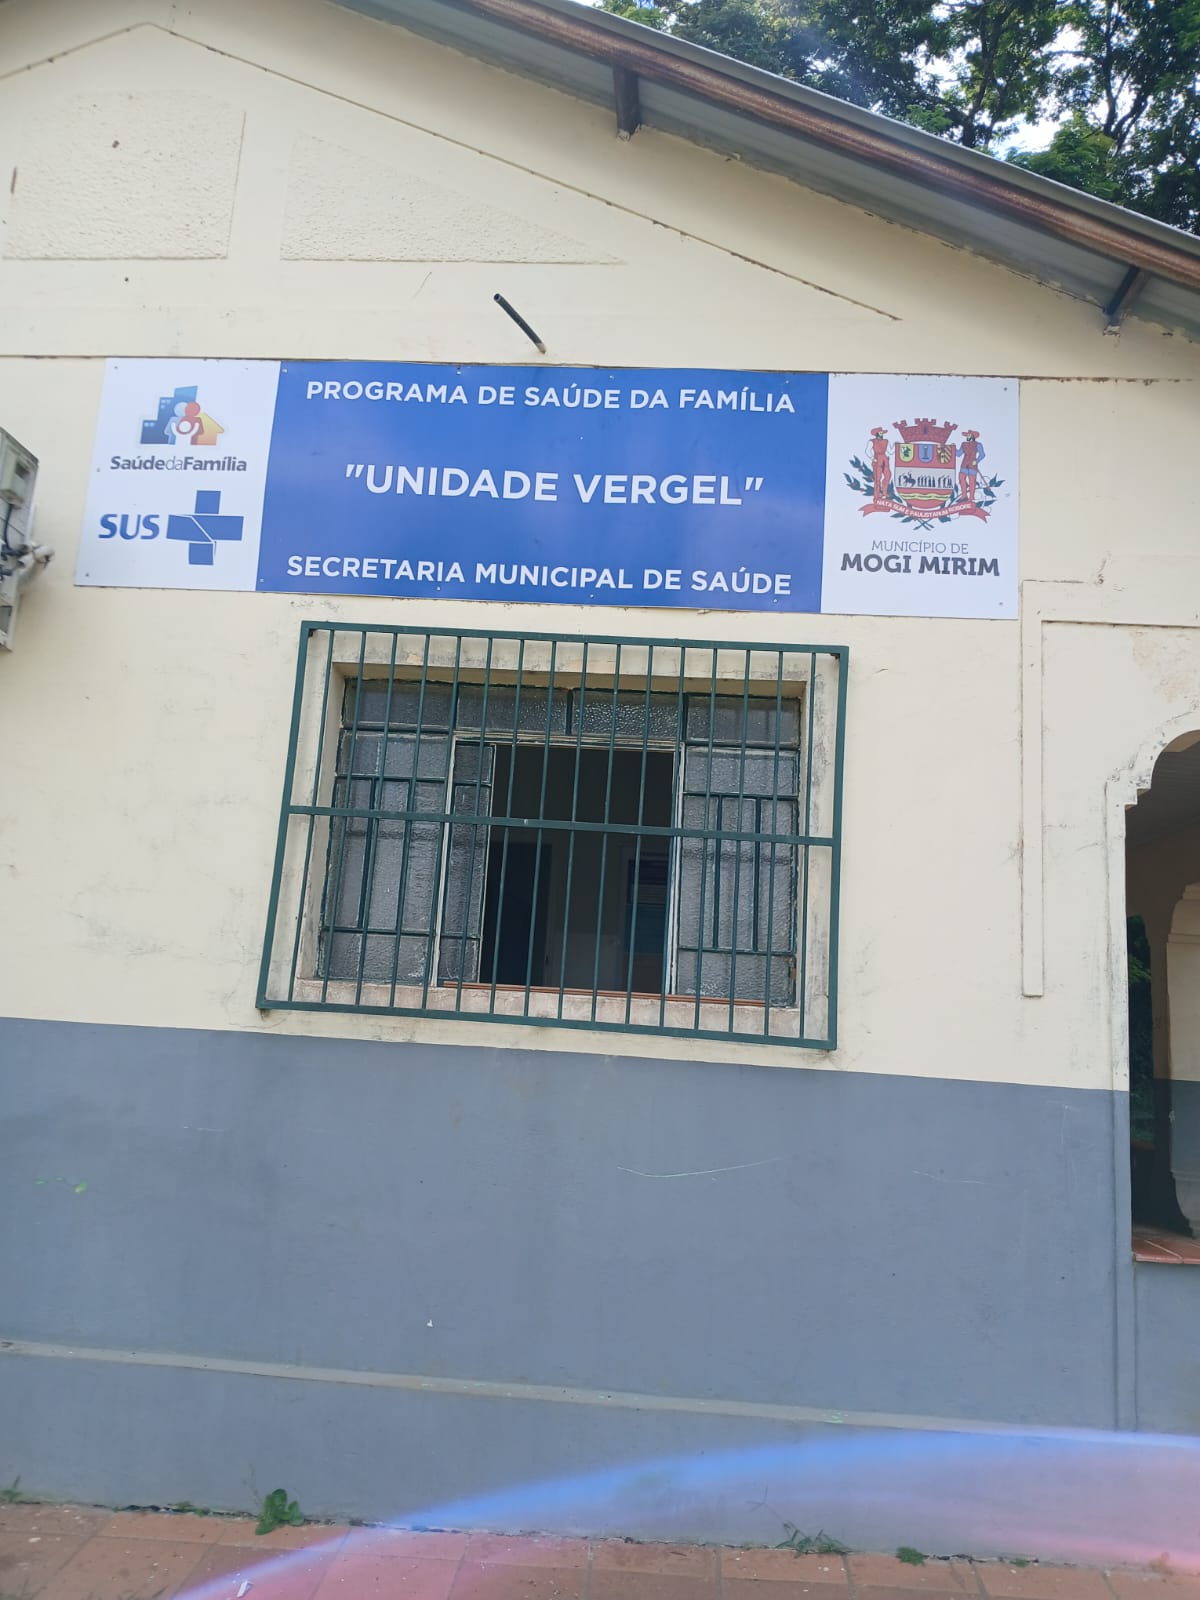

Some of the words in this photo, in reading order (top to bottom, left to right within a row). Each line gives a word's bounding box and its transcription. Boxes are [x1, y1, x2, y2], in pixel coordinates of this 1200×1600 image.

[306, 381, 468, 404] PROGRAMA
[478, 386, 515, 406] DE
[524, 383, 620, 409] SAÚDE
[630, 389, 669, 409] DA
[679, 386, 795, 413] FAMÍLIA
[345, 464, 559, 501] "UNIDADE
[98, 514, 160, 540] SUS
[871, 540, 947, 554] MUNICÍPIO
[951, 543, 969, 555] DE
[287, 555, 465, 583] SECRETARIA
[475, 563, 633, 589] MUNICIPAL
[643, 569, 682, 590] DE
[691, 567, 792, 595] SAÚDE
[841, 553, 912, 573] MOGI
[918, 556, 1000, 576] MIRIM
